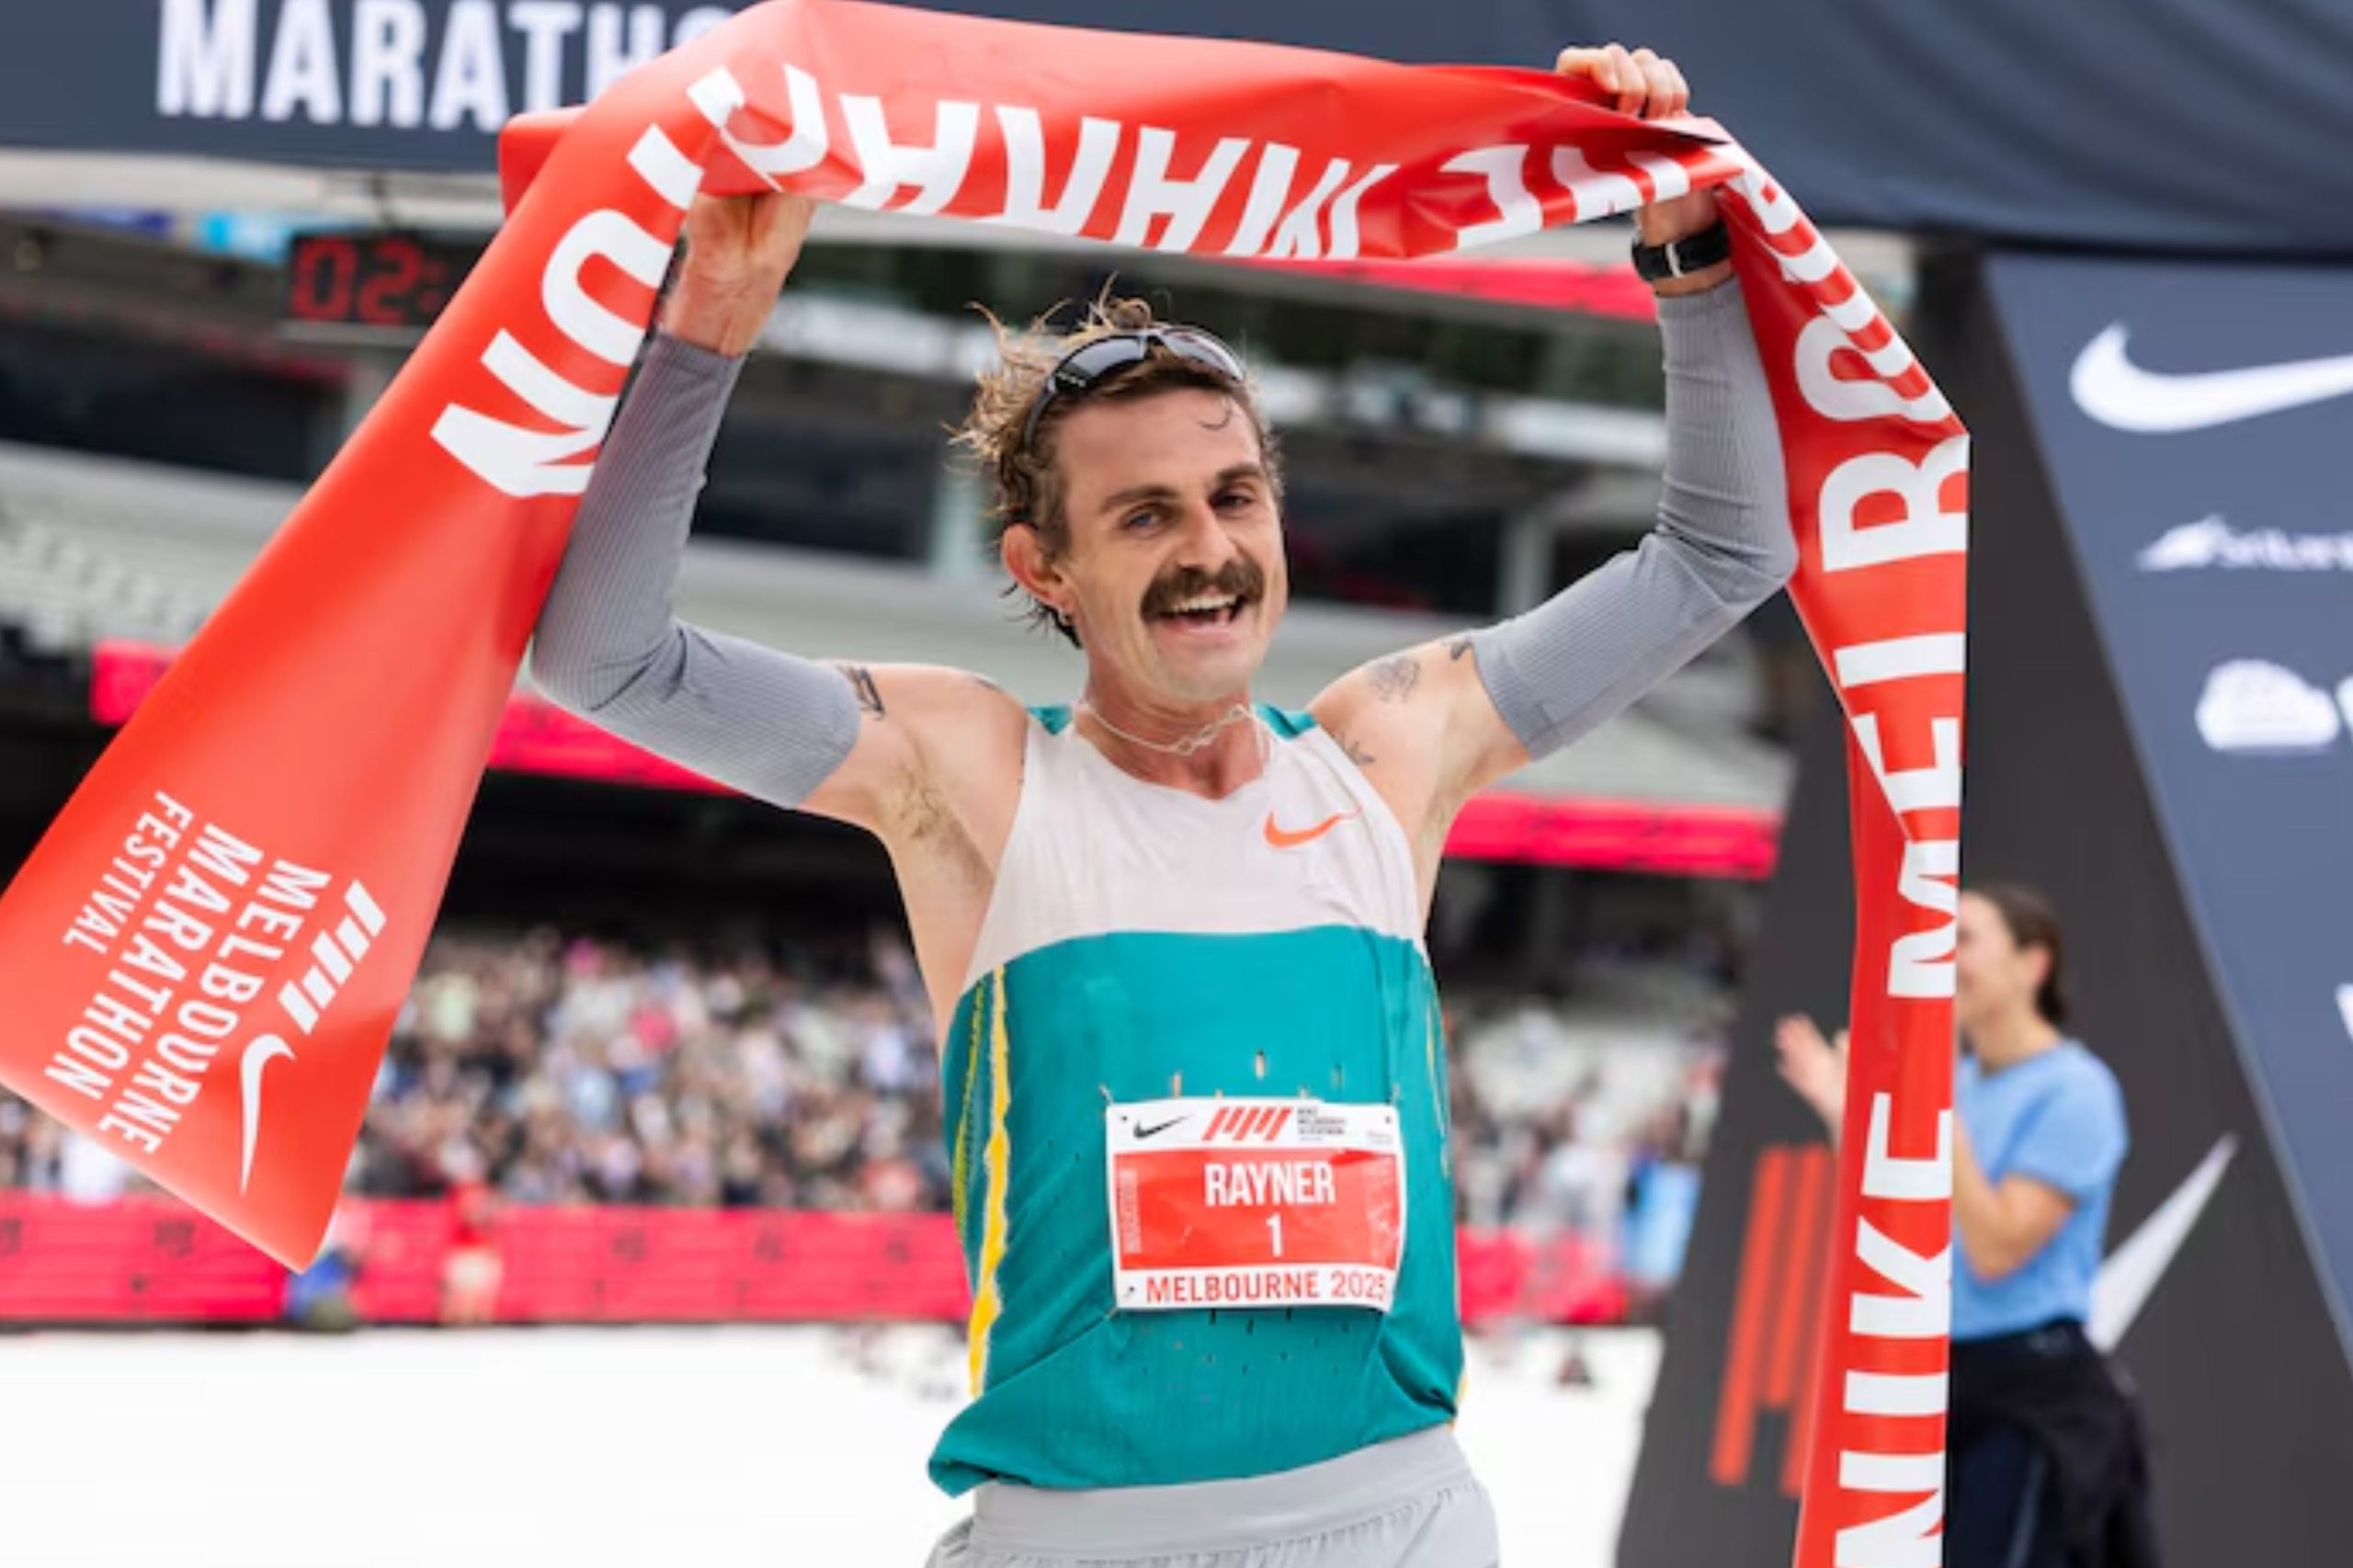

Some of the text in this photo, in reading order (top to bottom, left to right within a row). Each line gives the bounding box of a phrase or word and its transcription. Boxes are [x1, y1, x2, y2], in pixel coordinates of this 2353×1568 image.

[154, 0, 733, 131] MARATH
[63, 790, 194, 955] FESTIVAL
[43, 823, 264, 1101] MARATHON
[95, 859, 332, 1155] MELBOURNE
[1204, 1159, 1337, 1207] RAYNER
[1265, 1213, 1283, 1257] 1
[1145, 1269, 1320, 1303] MELBOURNE
